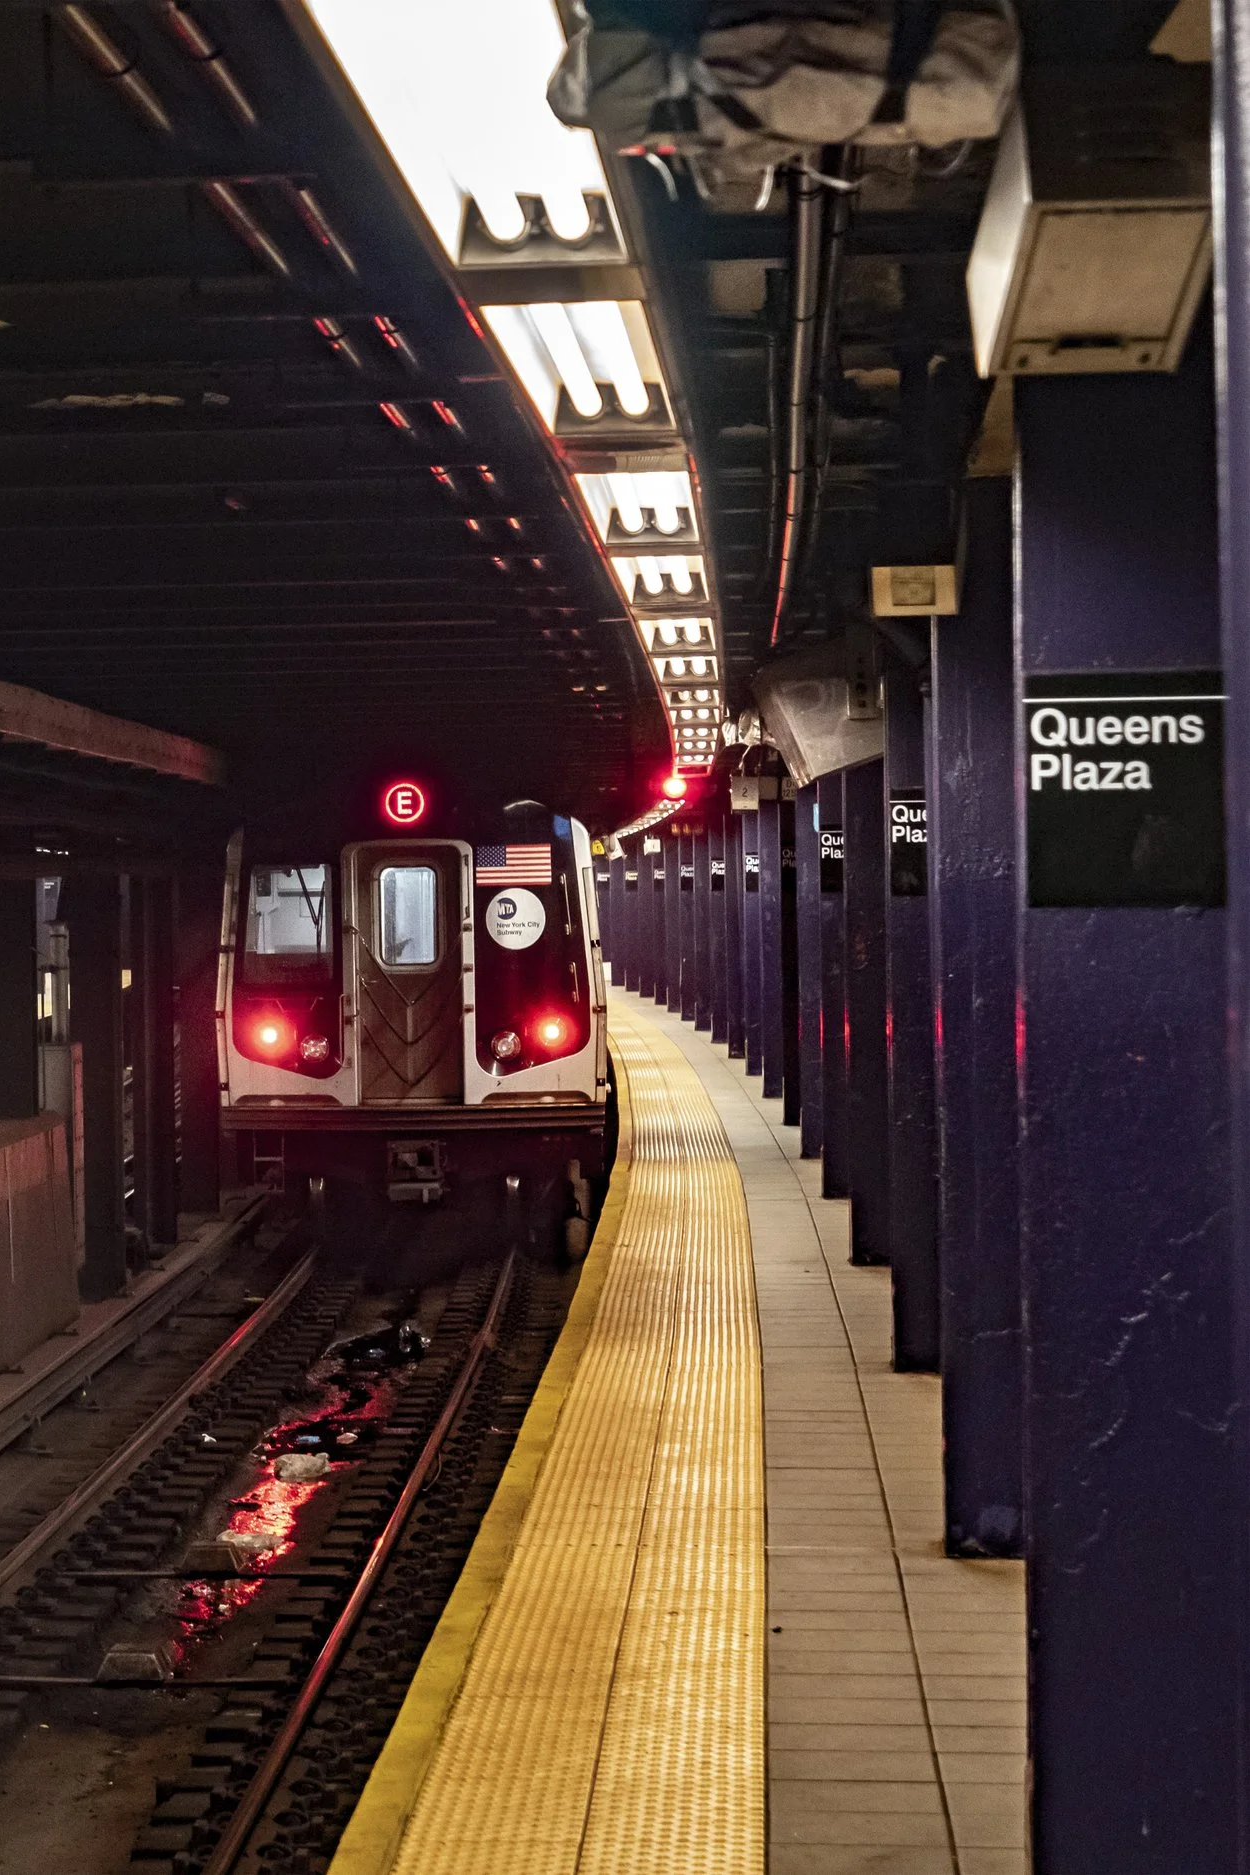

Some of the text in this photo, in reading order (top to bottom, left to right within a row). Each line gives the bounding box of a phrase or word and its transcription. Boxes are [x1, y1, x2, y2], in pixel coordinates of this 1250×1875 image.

[1030, 707, 1205, 746] Queens
[1030, 753, 1152, 791] Plaza
[397, 791, 412, 814] E
[742, 788, 748, 797] 2
